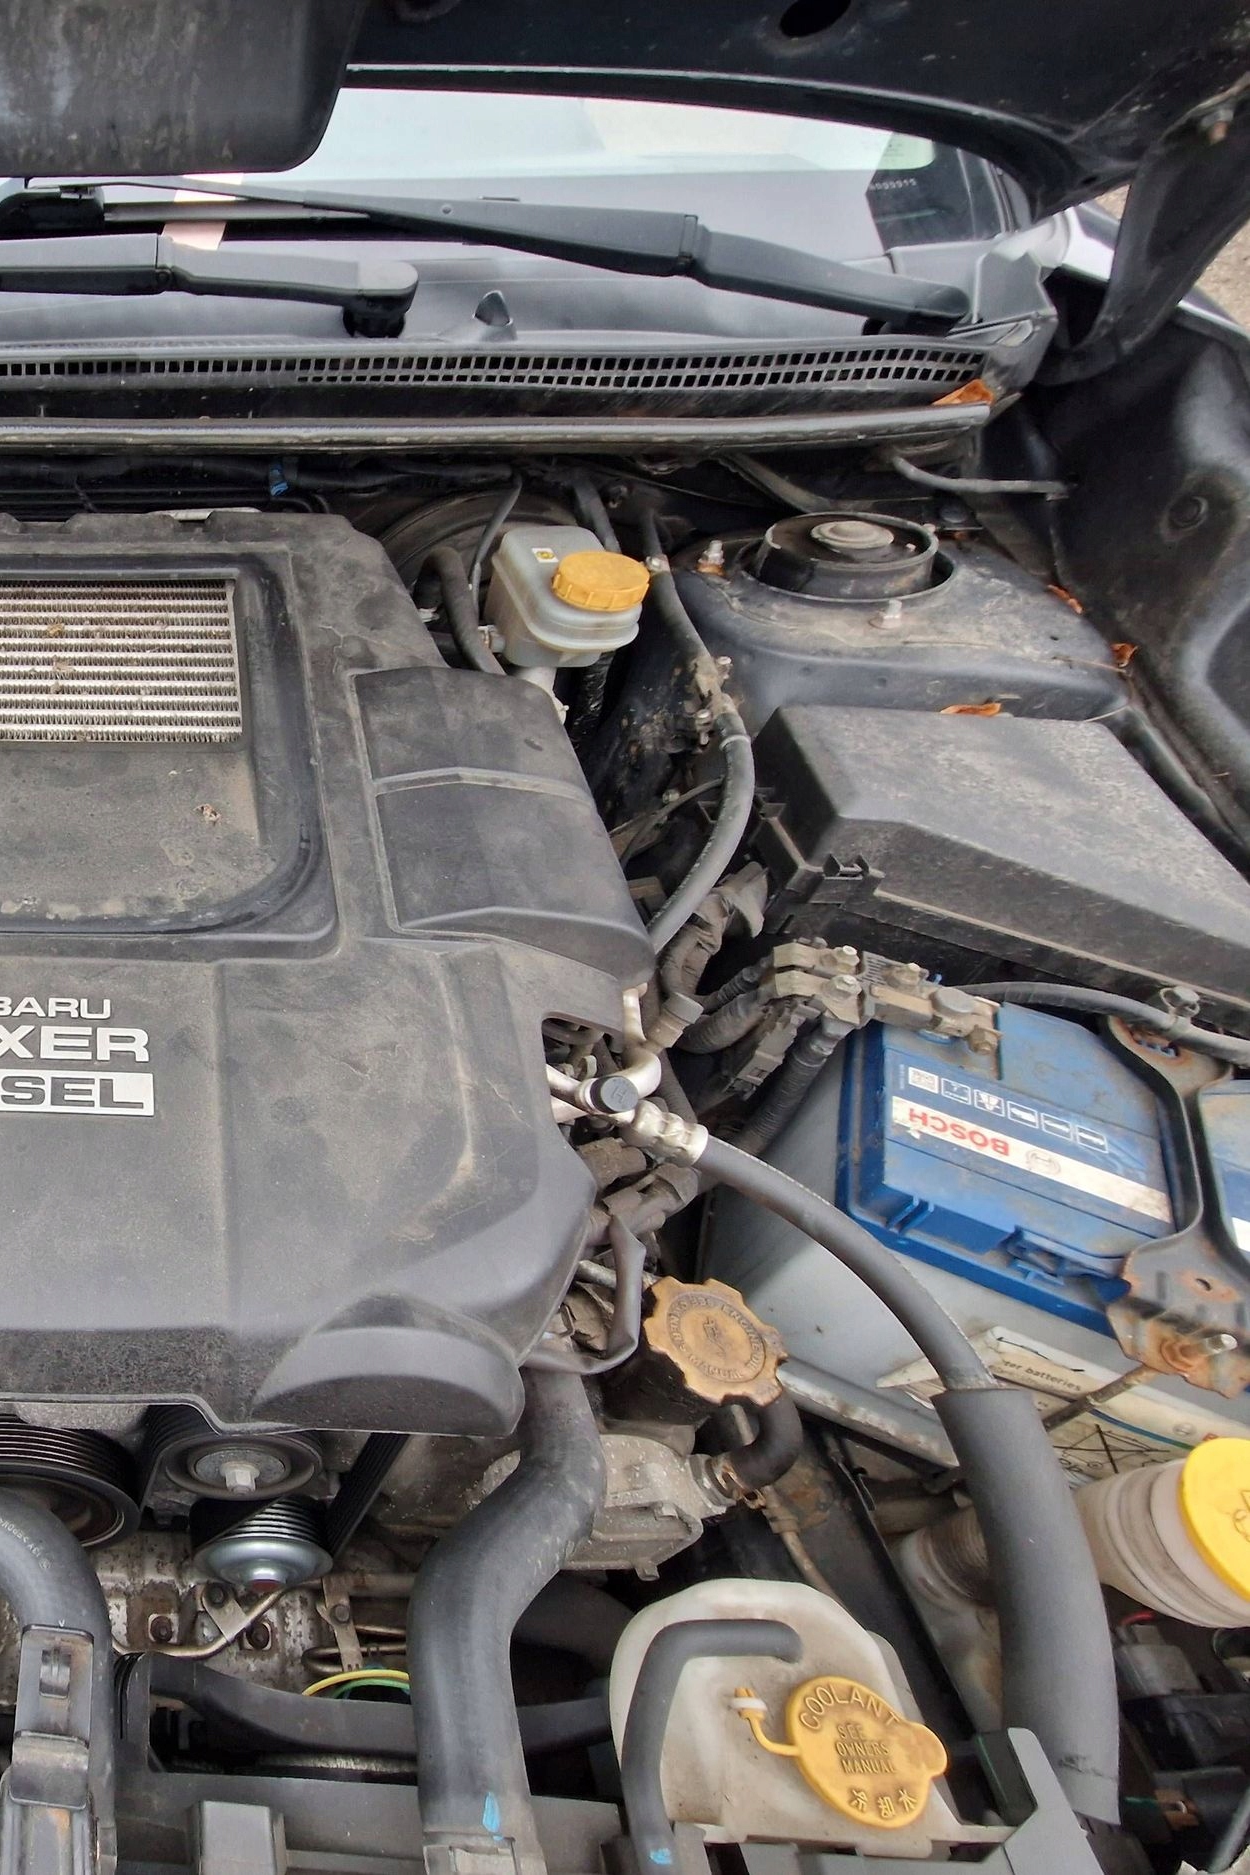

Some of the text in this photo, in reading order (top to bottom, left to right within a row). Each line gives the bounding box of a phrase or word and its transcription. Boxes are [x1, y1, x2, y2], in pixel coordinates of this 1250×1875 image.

[908, 1107, 1010, 1157] BOSCH
[1025, 1367, 1082, 1392] batteries
[800, 1683, 901, 1732] COOLANT
[837, 1722, 864, 1740] SEE
[835, 1740, 891, 1756] OWNERS
[840, 1757, 896, 1775] MANUAL
